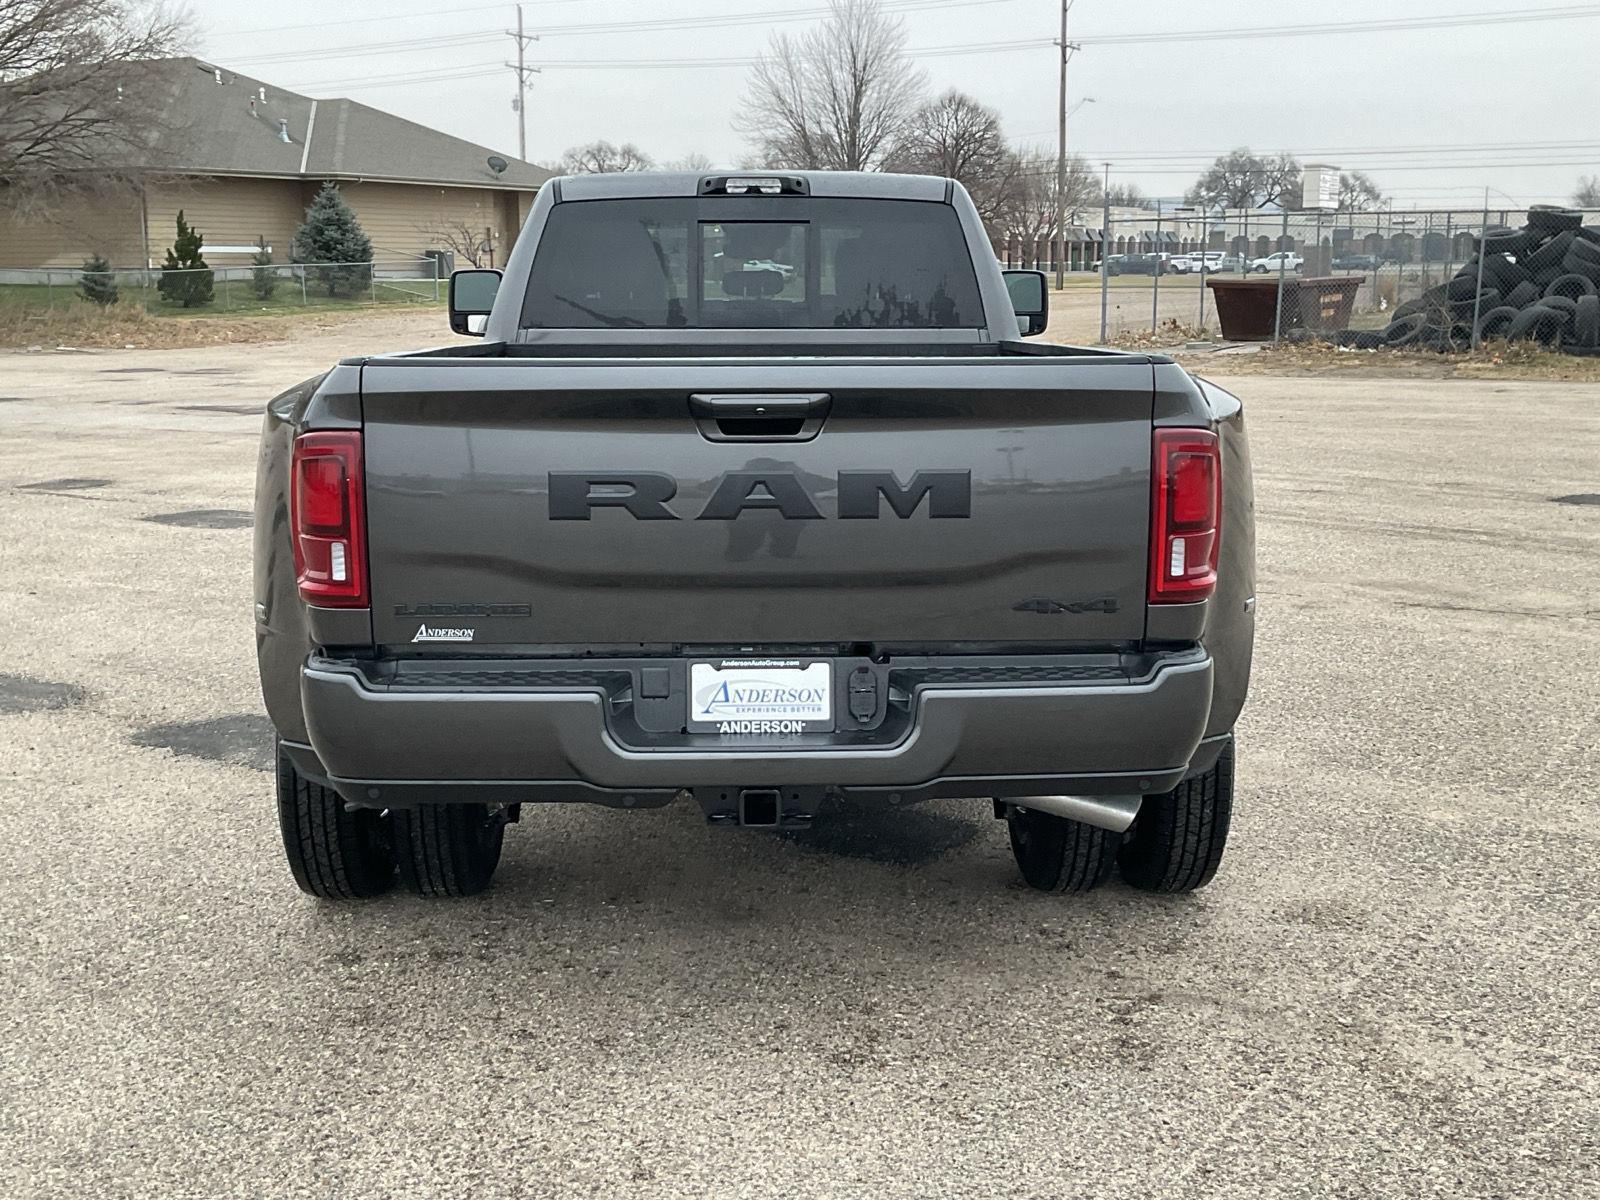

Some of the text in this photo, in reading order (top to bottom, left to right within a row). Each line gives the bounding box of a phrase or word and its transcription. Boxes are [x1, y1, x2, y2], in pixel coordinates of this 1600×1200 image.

[547, 469, 971, 520] RAM
[720, 659, 800, 668] AndersonAutoGroup.com
[736, 706, 822, 714] EXPERIENCE BETTER
